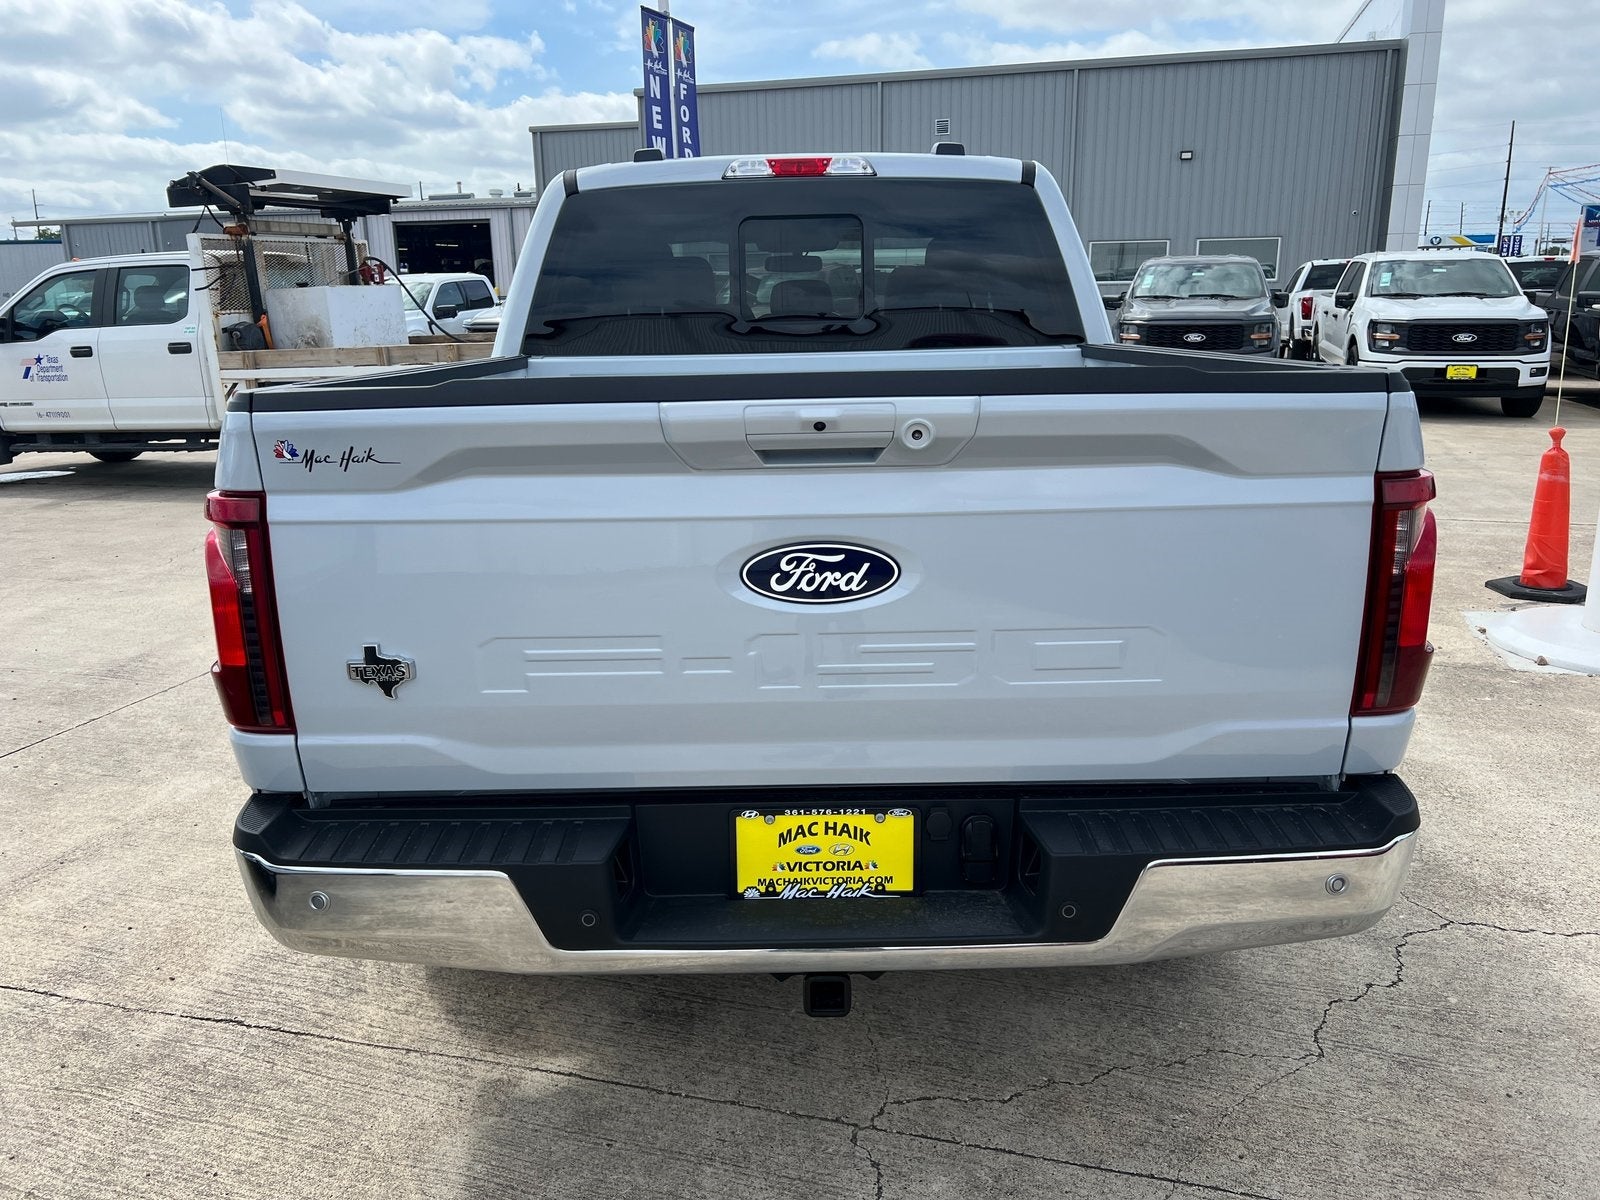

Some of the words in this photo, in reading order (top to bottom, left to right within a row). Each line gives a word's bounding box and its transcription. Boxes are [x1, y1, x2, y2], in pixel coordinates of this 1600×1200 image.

[650, 74, 667, 158] NEW
[679, 83, 694, 158] FORD
[45, 354, 59, 363] Texas
[37, 364, 64, 374] Department
[30, 373, 34, 382] of
[36, 373, 69, 382] Transportation
[298, 449, 337, 472] Mac
[339, 446, 398, 472] Haik
[770, 552, 871, 592] Ford
[477, 627, 1166, 693] F-150
[351, 664, 406, 678] TEXAS
[784, 808, 867, 816] 361-576-1221
[778, 821, 819, 848] MAC
[824, 821, 872, 846] HAIK
[785, 860, 864, 872] VICTORIA
[757, 875, 894, 887] MACHAIKVICTORIACOM
[779, 883, 825, 899] Mac
[826, 882, 877, 899] Haik
